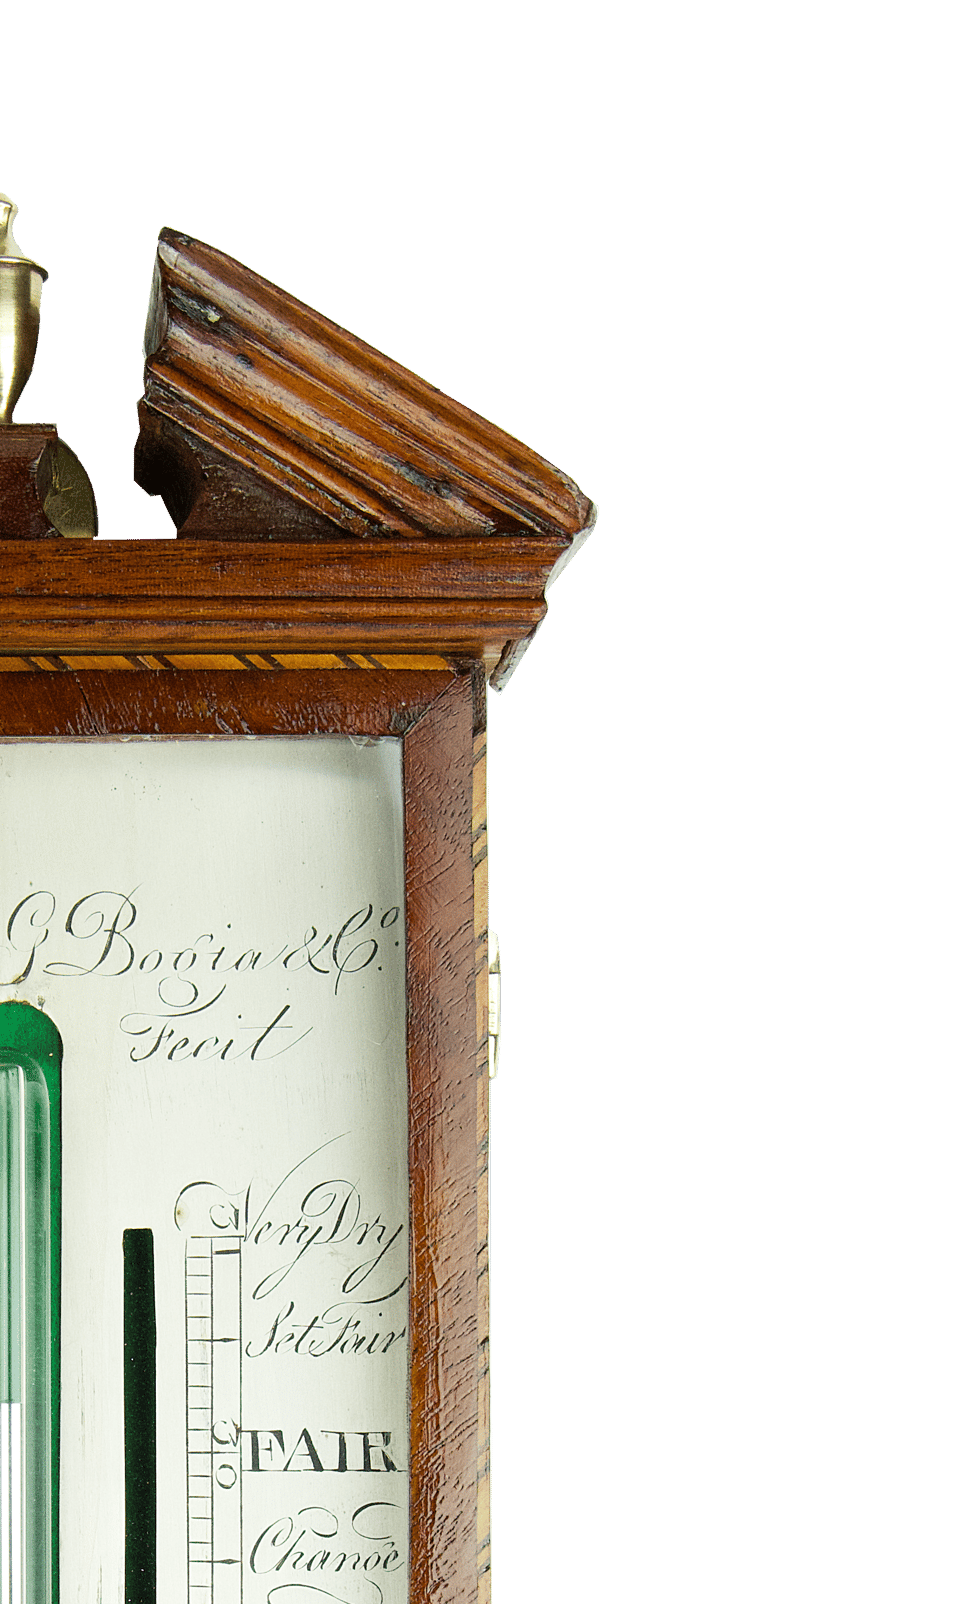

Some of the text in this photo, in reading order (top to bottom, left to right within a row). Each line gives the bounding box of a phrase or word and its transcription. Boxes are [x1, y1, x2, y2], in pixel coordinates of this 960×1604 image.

[120, 985, 313, 1063] Fecit
[301, 1179, 404, 1294] Dry
[245, 1276, 408, 1358] Set Fair
[241, 1427, 408, 1473] FAIR
